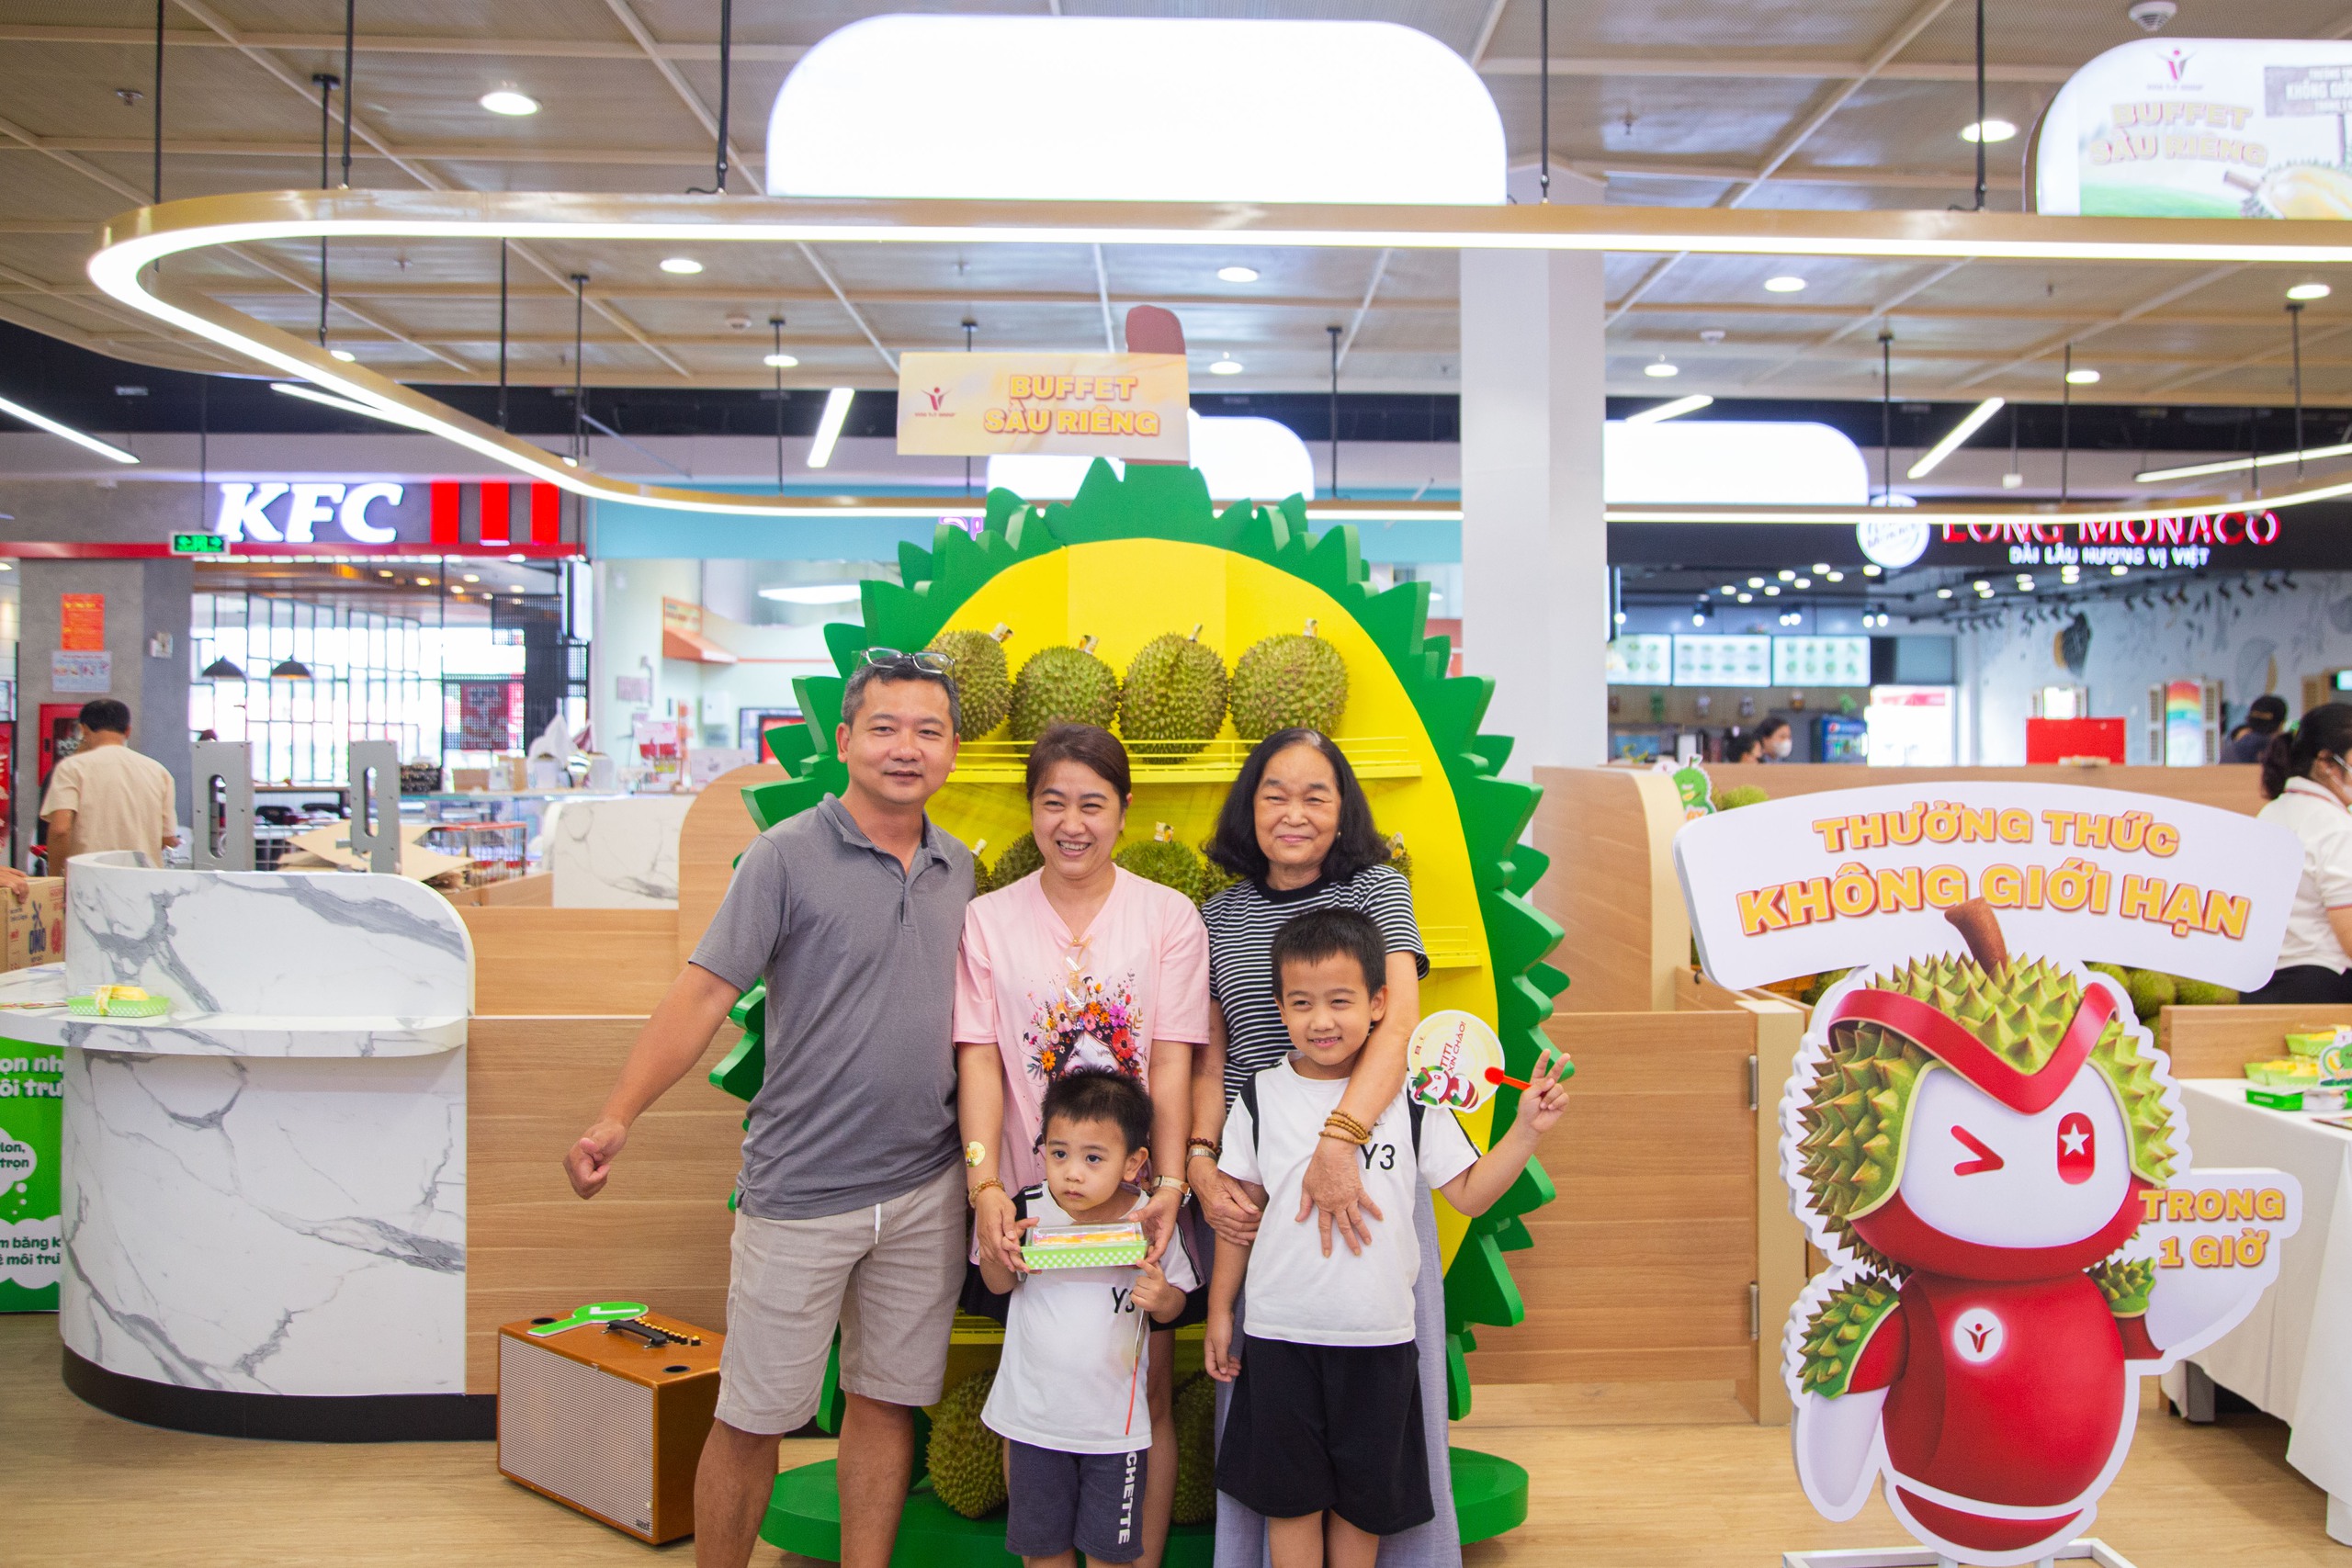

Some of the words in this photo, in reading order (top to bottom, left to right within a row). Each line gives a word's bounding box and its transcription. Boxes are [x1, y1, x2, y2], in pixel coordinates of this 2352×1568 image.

[2111, 101, 2254, 130] BUFFET
[2164, 133, 2268, 169] RIÊNG
[1009, 374, 1138, 400] BUFFET
[984, 399, 1052, 434] SẦU
[1057, 404, 1161, 436] RIÊNG
[215, 482, 405, 544] KFC
[1812, 801, 2032, 852] THƯỞNG
[2041, 810, 2180, 856] THỨC
[1736, 863, 1969, 937] KHÔNG
[1979, 858, 2110, 912] GIỚI
[2120, 874, 2252, 940] HẠN
[1440, 1043, 1453, 1067] TITI
[1448, 1055, 1457, 1073] XIN
[1453, 1021, 1466, 1055] CHÀO!
[0, 1157, 29, 1171] trọn
[1359, 1143, 1396, 1171] Y3
[2138, 1188, 2286, 1222] TRONG
[6, 1253, 33, 1265] môi
[13, 1236, 49, 1251] băng
[2159, 1235, 2184, 1269] 1
[2189, 1227, 2270, 1268] GIỜ
[1118, 1451, 1137, 1545] CHETTE
